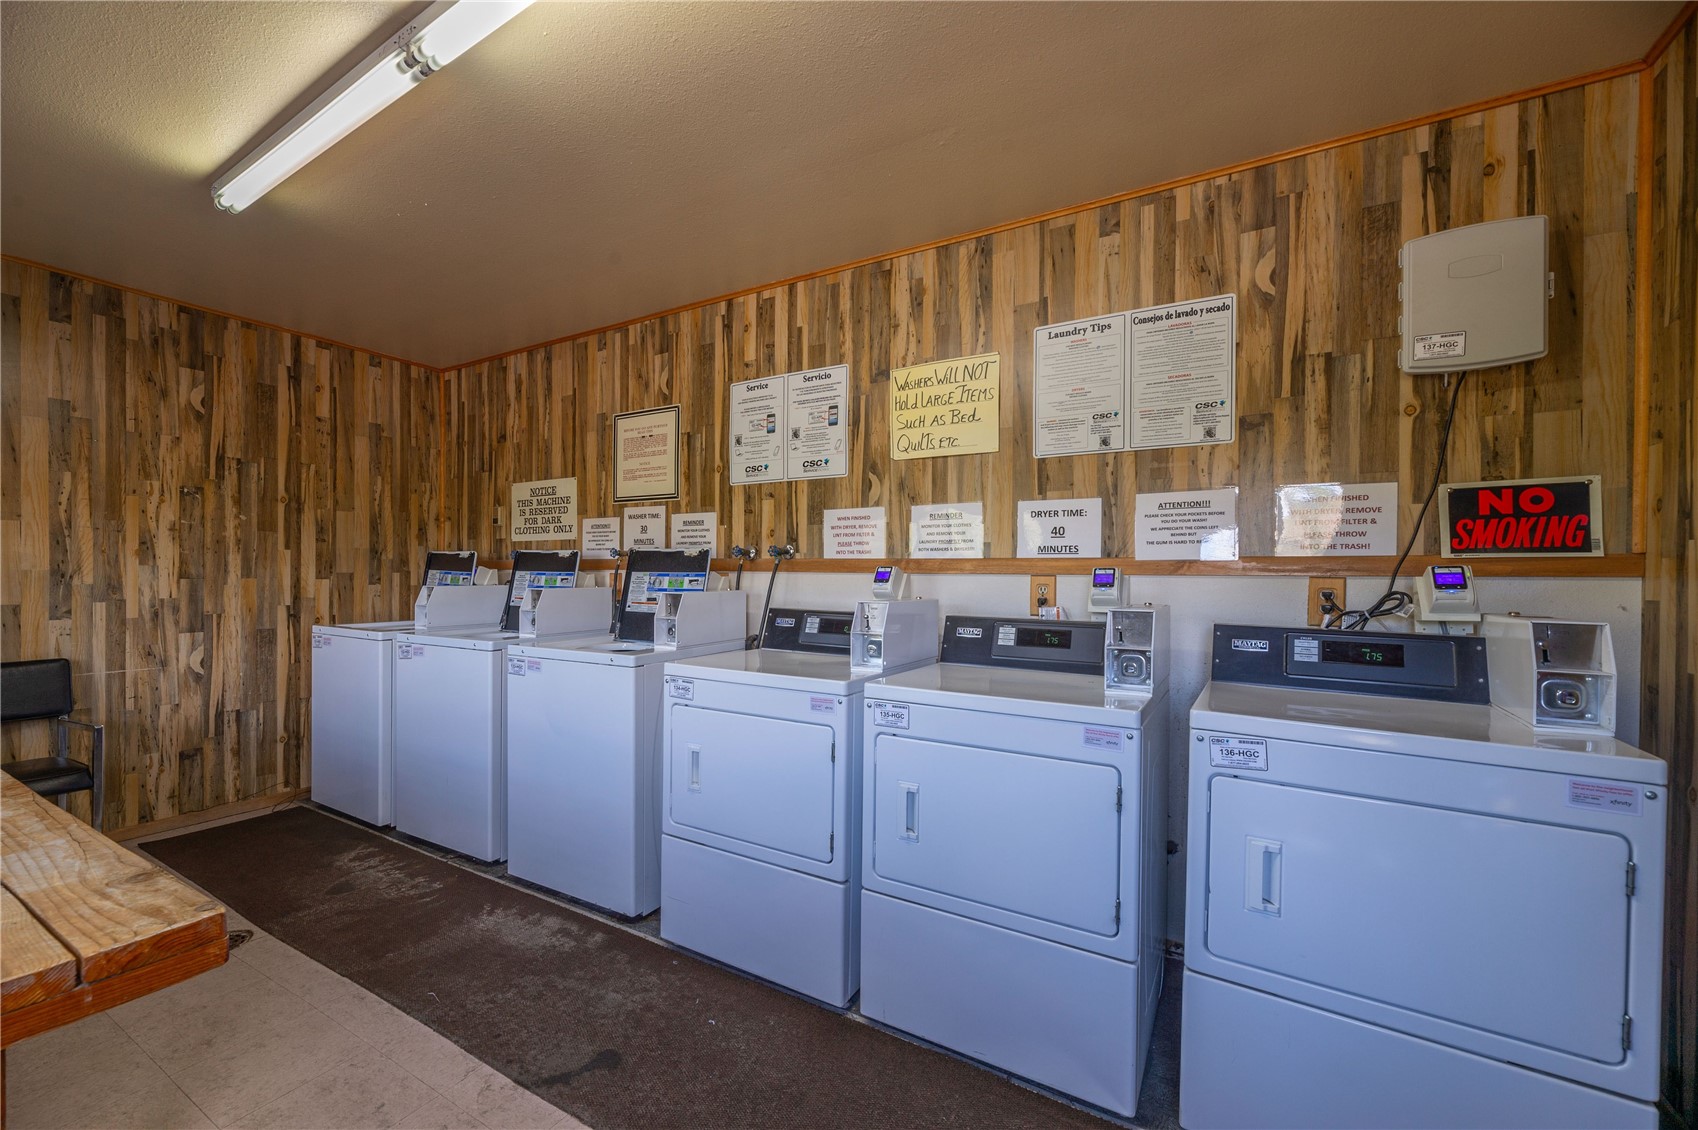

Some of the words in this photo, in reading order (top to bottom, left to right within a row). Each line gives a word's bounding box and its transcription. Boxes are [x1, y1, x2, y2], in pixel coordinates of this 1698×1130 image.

[1133, 314, 1163, 325] Consejos
[1164, 311, 1173, 320] de
[1175, 308, 1198, 319] lavado
[1200, 308, 1204, 317] y
[1206, 302, 1230, 314] secado
[1048, 327, 1088, 340] Laundry
[1090, 323, 1112, 333] Tips
[1422, 341, 1458, 350] 137-HGC
[963, 360, 997, 382] NOT
[803, 372, 831, 382] Servicio
[746, 383, 769, 392] Service
[1195, 401, 1218, 409] CSC
[930, 415, 946, 426] AS
[802, 460, 822, 468] CSC
[745, 465, 763, 473] CSC
[530, 486, 556, 496] NOTICE
[536, 496, 571, 506] MACHINE
[1158, 500, 1211, 510] ATTENTION!!!
[1478, 487, 1555, 515] NO
[529, 506, 568, 516] RESERVED
[1030, 510, 1059, 518] DRYER
[1062, 509, 1087, 517] TIME:
[542, 516, 562, 524] DARK
[515, 526, 550, 535] CLOTHING
[553, 525, 573, 533] ONLY
[1050, 527, 1065, 536] 40
[1452, 514, 1588, 549] SMOKING
[1038, 545, 1079, 553] MINUTES
[1234, 640, 1267, 648] MAYTAG
[880, 711, 904, 720] 135-HGC
[1220, 749, 1259, 758] 136-HGC
